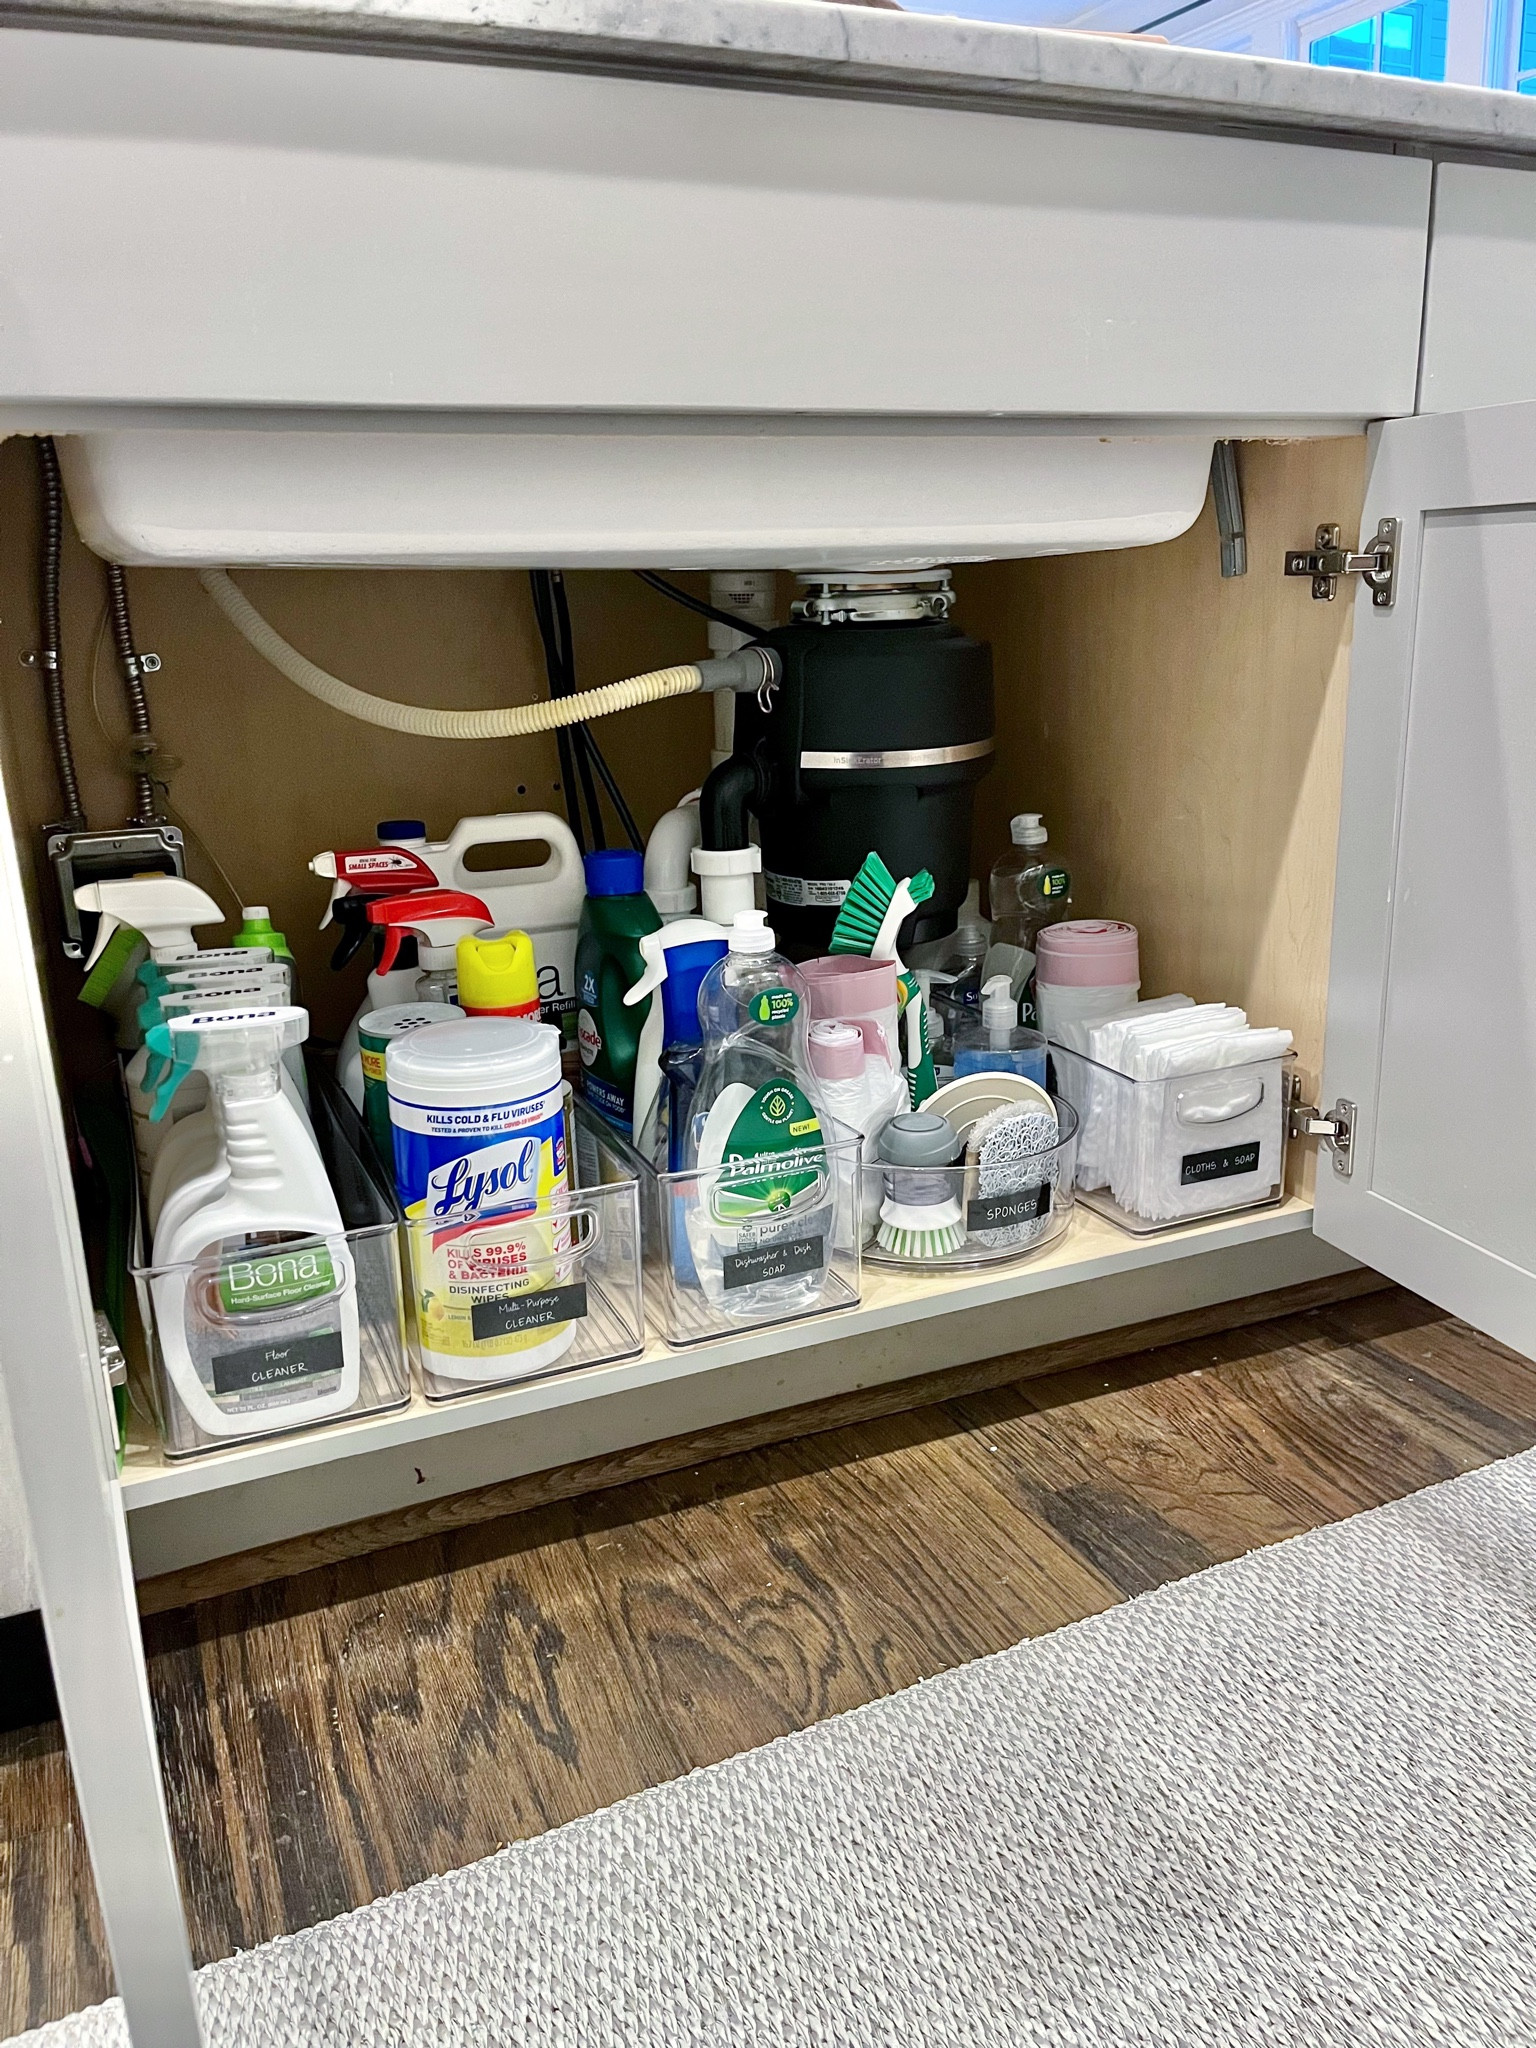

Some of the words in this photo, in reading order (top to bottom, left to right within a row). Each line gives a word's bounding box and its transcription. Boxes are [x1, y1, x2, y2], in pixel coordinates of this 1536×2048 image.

[367, 861, 389, 869] SPACES
[176, 950, 248, 960] Bona
[187, 967, 263, 979] Bona
[584, 974, 595, 994] 2X
[182, 987, 261, 1000] Bona
[552, 1000, 576, 1012] Refill
[771, 998, 794, 1009] 100%
[192, 1011, 276, 1024] Bona
[606, 1092, 625, 1107] AWAY
[426, 1114, 453, 1125] KILLS
[454, 1114, 481, 1125] COLD
[482, 1114, 489, 1123] &
[491, 1111, 510, 1122] FLU
[431, 1126, 452, 1134] TESTED
[792, 1124, 811, 1134] NEW!
[728, 1153, 824, 1178] Palmolive
[1185, 1161, 1217, 1175] CLOTHS
[1222, 1159, 1229, 1168] &
[1234, 1153, 1256, 1166] SOAP
[431, 1139, 533, 1216] Lysol
[986, 1199, 1037, 1220] SPONGES
[486, 1242, 526, 1256] 99.9%
[735, 1250, 779, 1268] Dishwasher
[794, 1243, 812, 1255] Dish
[448, 1260, 463, 1270] OF
[762, 1264, 786, 1277] SOAP
[229, 1254, 320, 1291] Bona
[449, 1271, 457, 1280] &
[231, 1292, 282, 1305] Hard-Surface
[283, 1287, 302, 1297] Floor
[303, 1280, 331, 1292] Cleaner
[449, 1279, 530, 1295] DISINFECTING
[498, 1295, 560, 1315] Multi-Purpose
[505, 1311, 556, 1330] CLEANER
[265, 1348, 291, 1362] Floor
[251, 1362, 309, 1383] CLEANER
